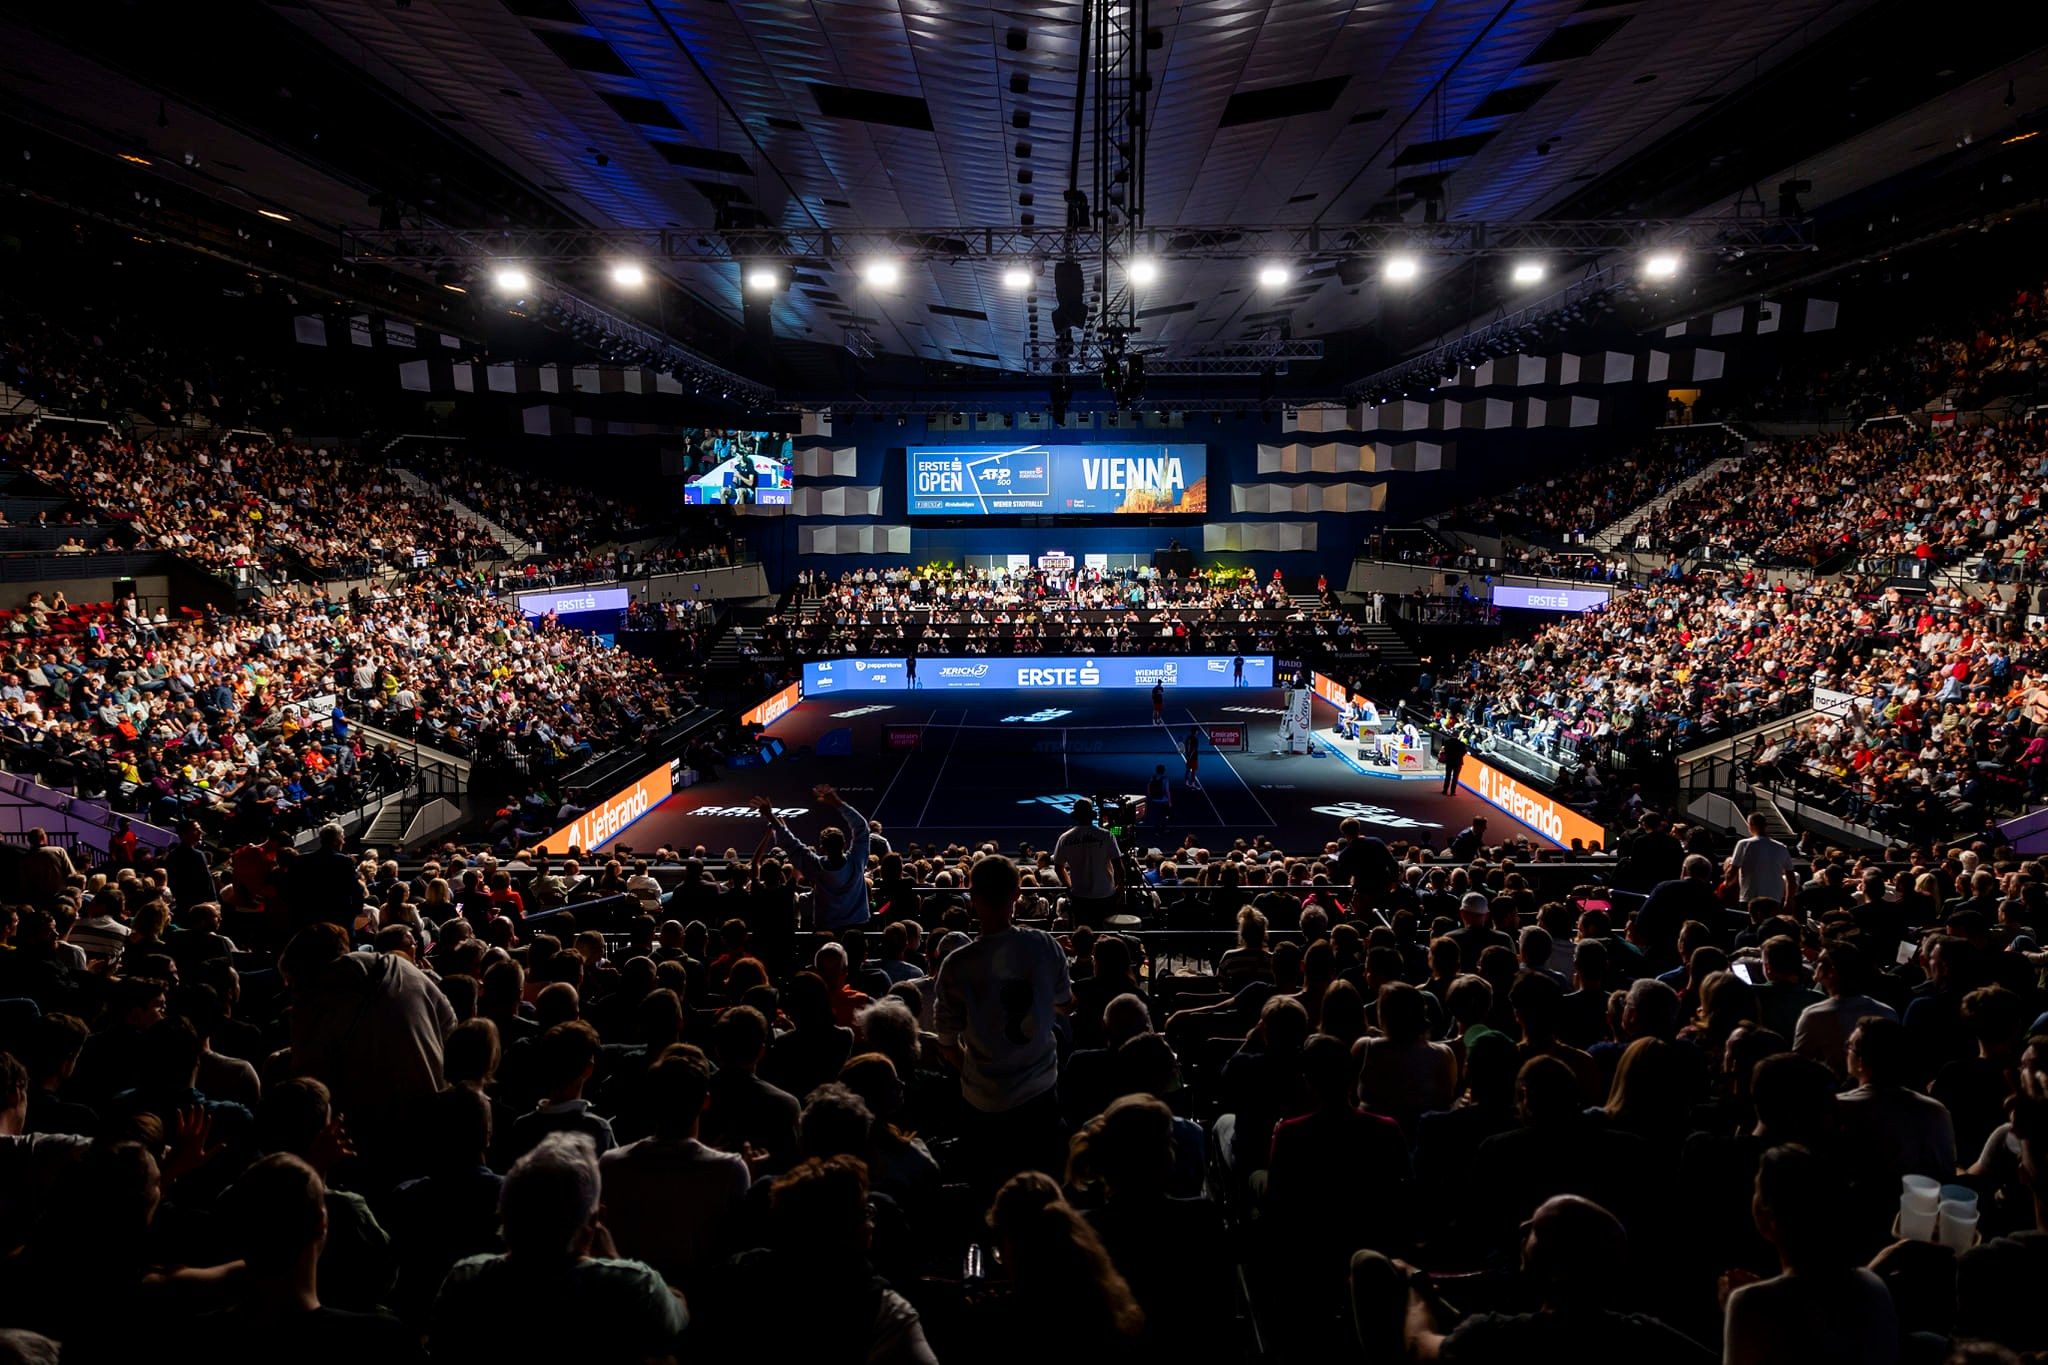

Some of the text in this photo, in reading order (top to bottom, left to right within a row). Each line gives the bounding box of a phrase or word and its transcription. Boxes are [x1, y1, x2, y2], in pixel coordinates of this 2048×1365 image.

[918, 461, 950, 471] ERSTE
[978, 468, 1011, 480] ATP
[1082, 458, 1185, 490] VIENNA
[919, 472, 963, 492] OPEN
[777, 496, 785, 504] GO
[557, 598, 585, 611] ERSTE
[1528, 595, 1557, 607] ERSTE
[1278, 659, 1302, 668] RADO
[939, 667, 975, 675] JERICH
[1018, 668, 1077, 686] ERSTE
[1816, 696, 1837, 706] nord
[1492, 772, 1562, 841] Lieferando
[584, 783, 648, 850] Lieferando
